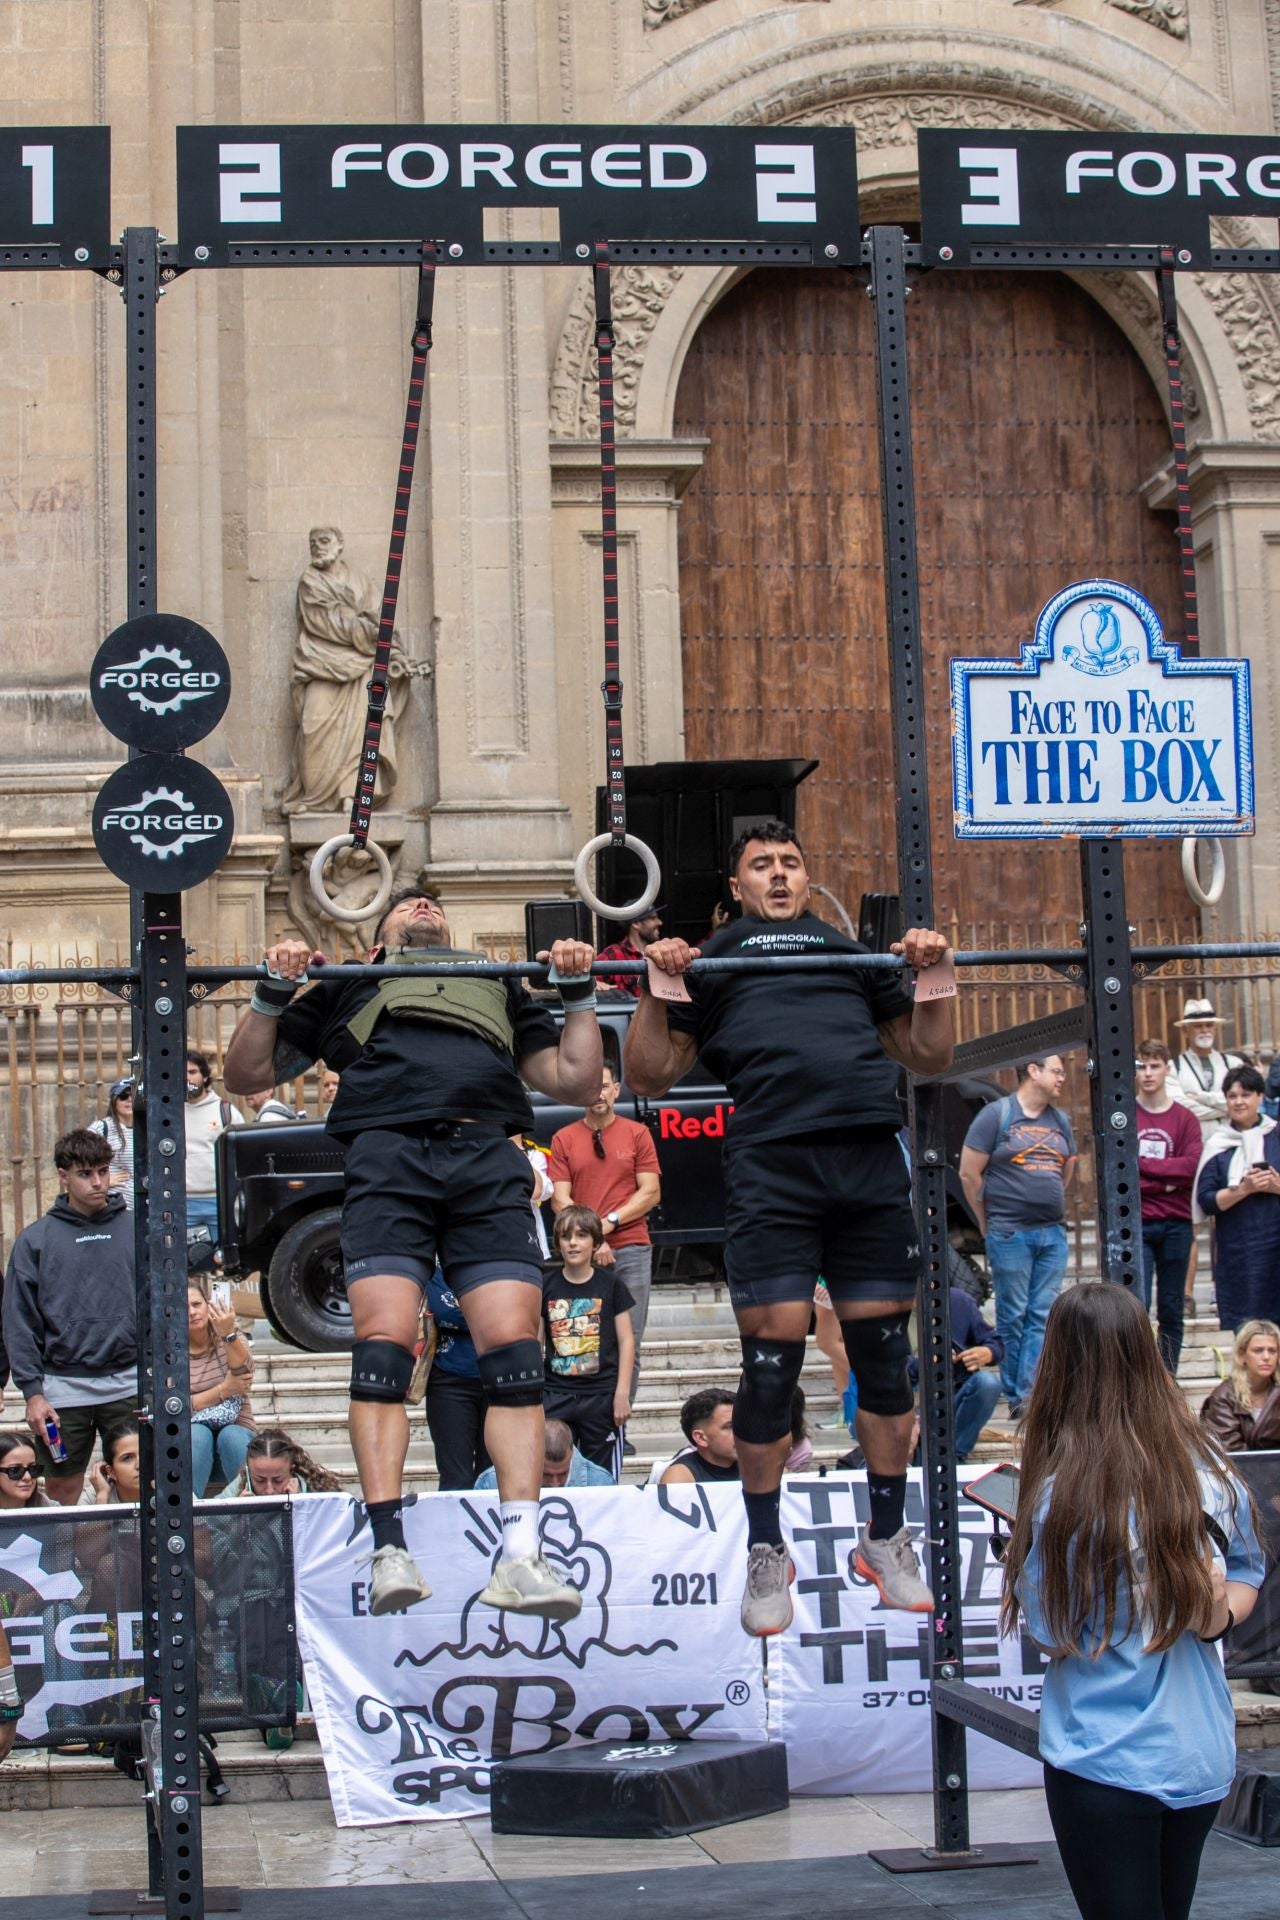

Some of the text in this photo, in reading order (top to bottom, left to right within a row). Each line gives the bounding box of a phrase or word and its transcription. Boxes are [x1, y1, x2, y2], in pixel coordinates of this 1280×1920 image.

[22, 145, 54, 225] 1
[219, 143, 817, 223] 2 FORGED 2
[958, 147, 1021, 226] 3
[100, 672, 221, 689] FORGED
[1008, 689, 1195, 735] FACE TO FACE
[981, 738, 1226, 805] THE BOX
[102, 814, 223, 831] FORGED
[660, 1104, 725, 1139] Red
[652, 1573, 718, 1606] 2021
[355, 1694, 482, 1765] The
